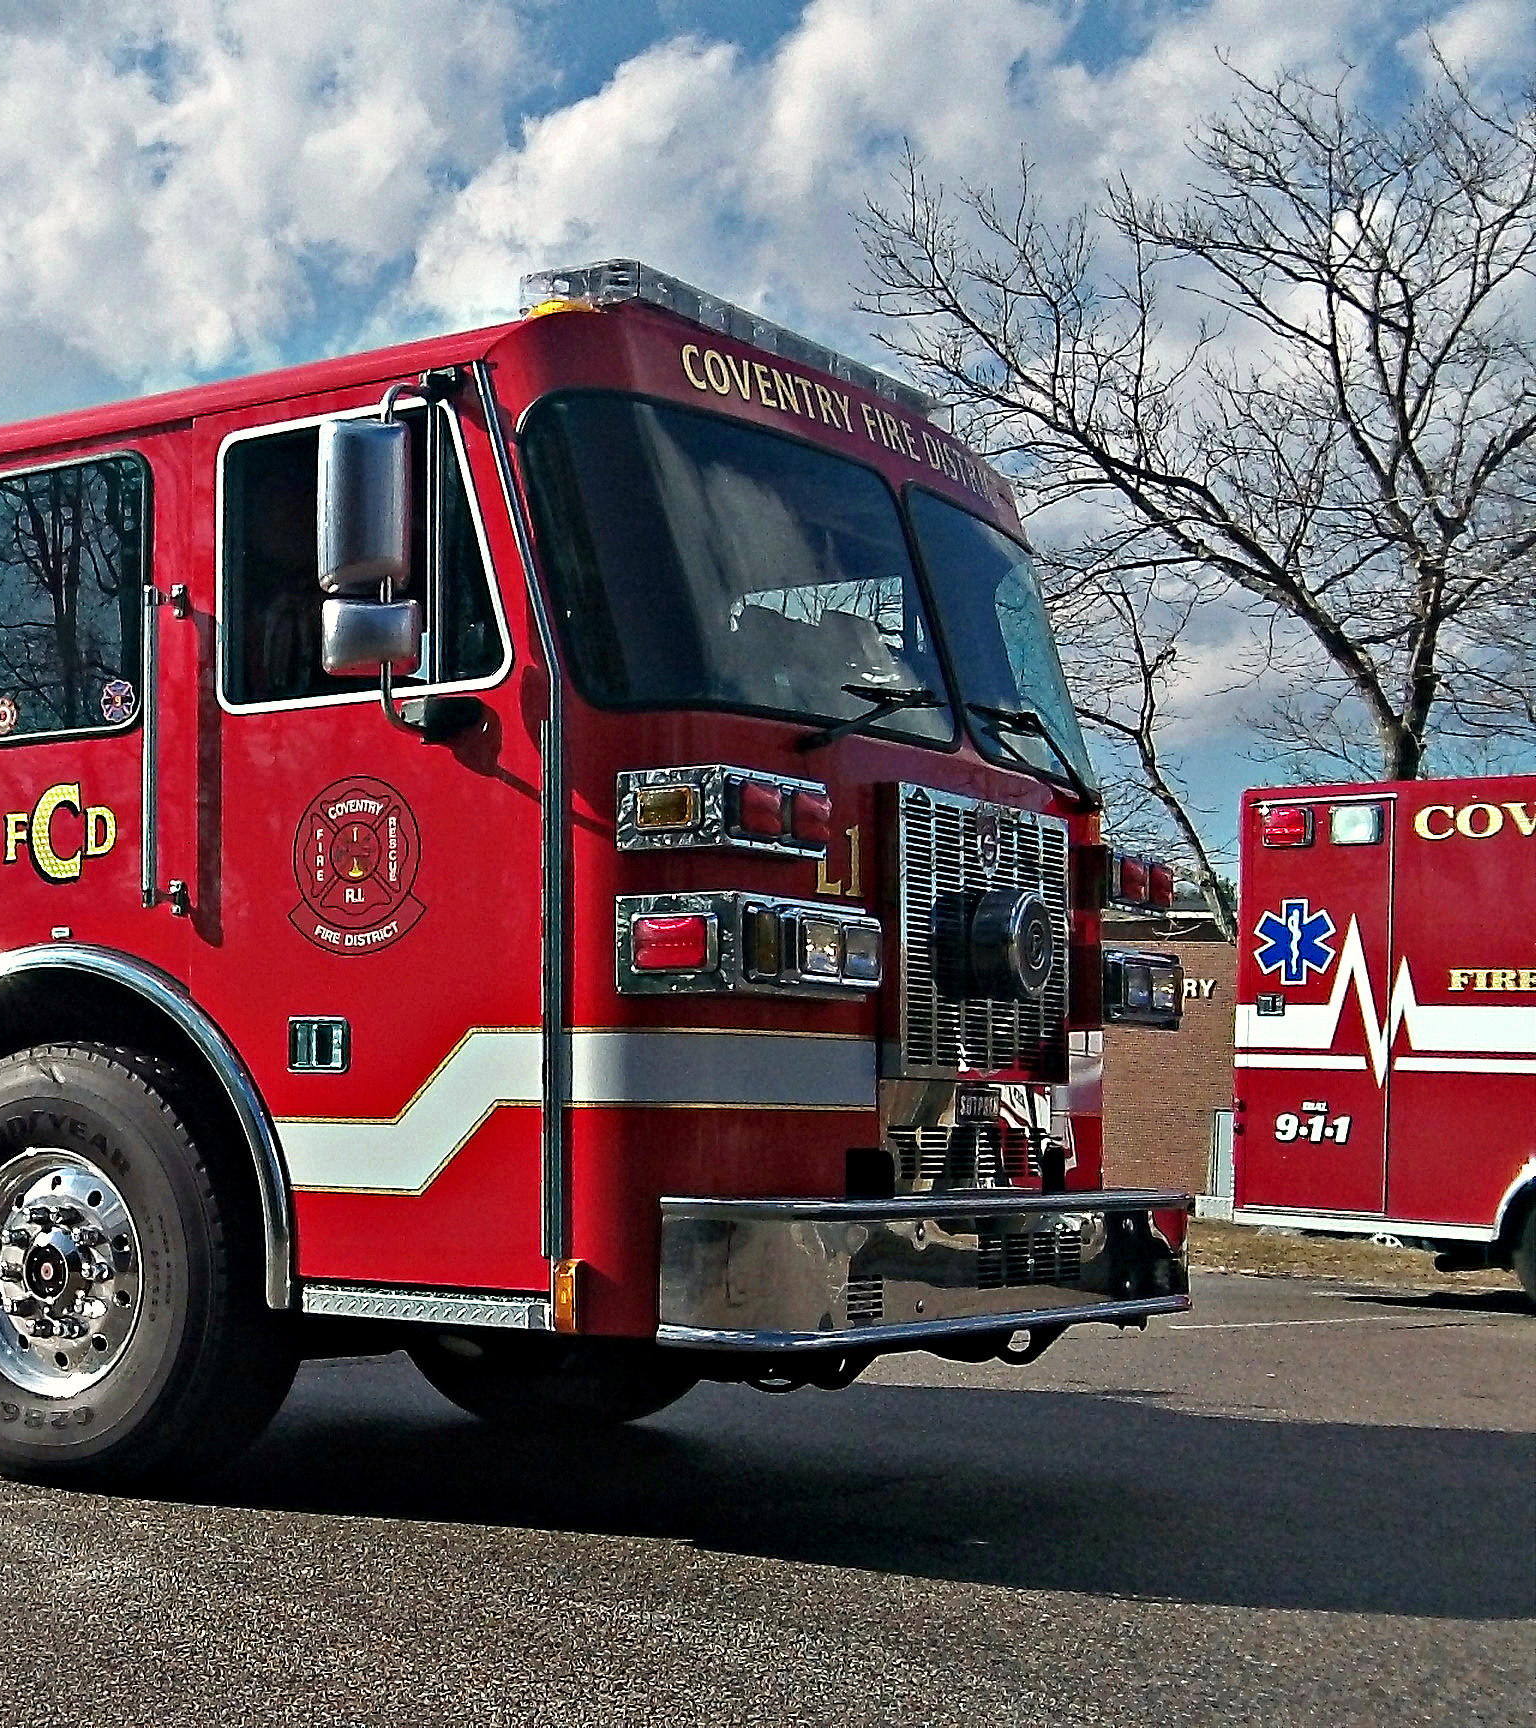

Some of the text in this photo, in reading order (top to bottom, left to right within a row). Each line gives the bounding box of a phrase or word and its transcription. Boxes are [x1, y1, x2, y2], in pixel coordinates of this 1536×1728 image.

[681, 344, 997, 508] COVENTRY FIRE DISTRI
[328, 799, 383, 820] COVENTRY
[1413, 802, 1536, 841] COV
[316, 828, 324, 882] FIRE
[388, 817, 398, 882] RESCUE
[314, 921, 399, 947] FIRE DISTRICT
[1447, 968, 1536, 992] FIRE
